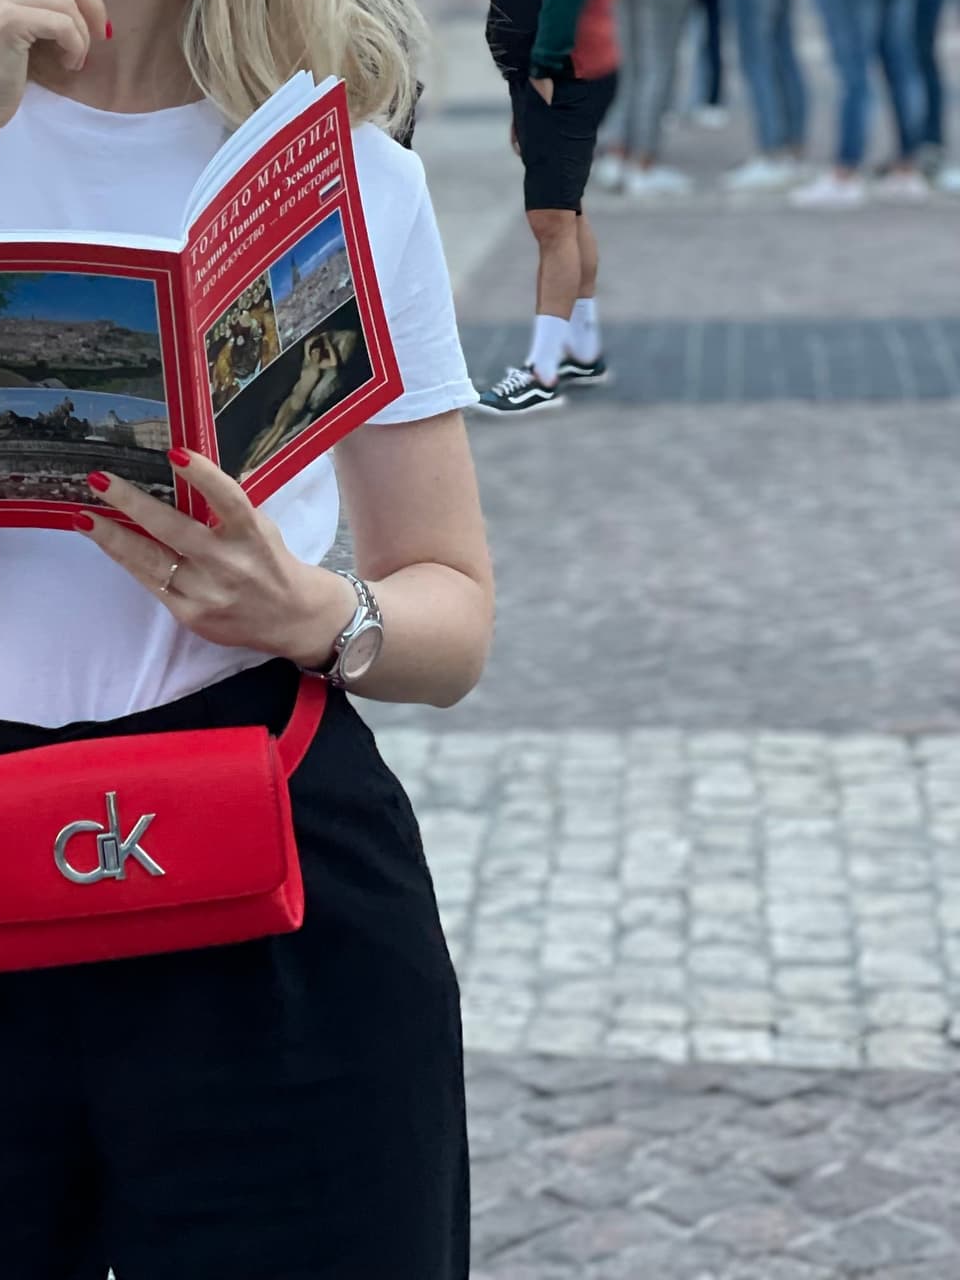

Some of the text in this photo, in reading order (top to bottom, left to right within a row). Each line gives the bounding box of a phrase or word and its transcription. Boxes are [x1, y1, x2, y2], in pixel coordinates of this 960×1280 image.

[190, 114, 335, 266] ТОЛЕДО МАДРИД
[193, 141, 336, 289] Долина Павших и Эскориал
[202, 274, 217, 297] ЕГО
[217, 223, 265, 279] ИСКУССТВО
[279, 195, 296, 217] ЕГО
